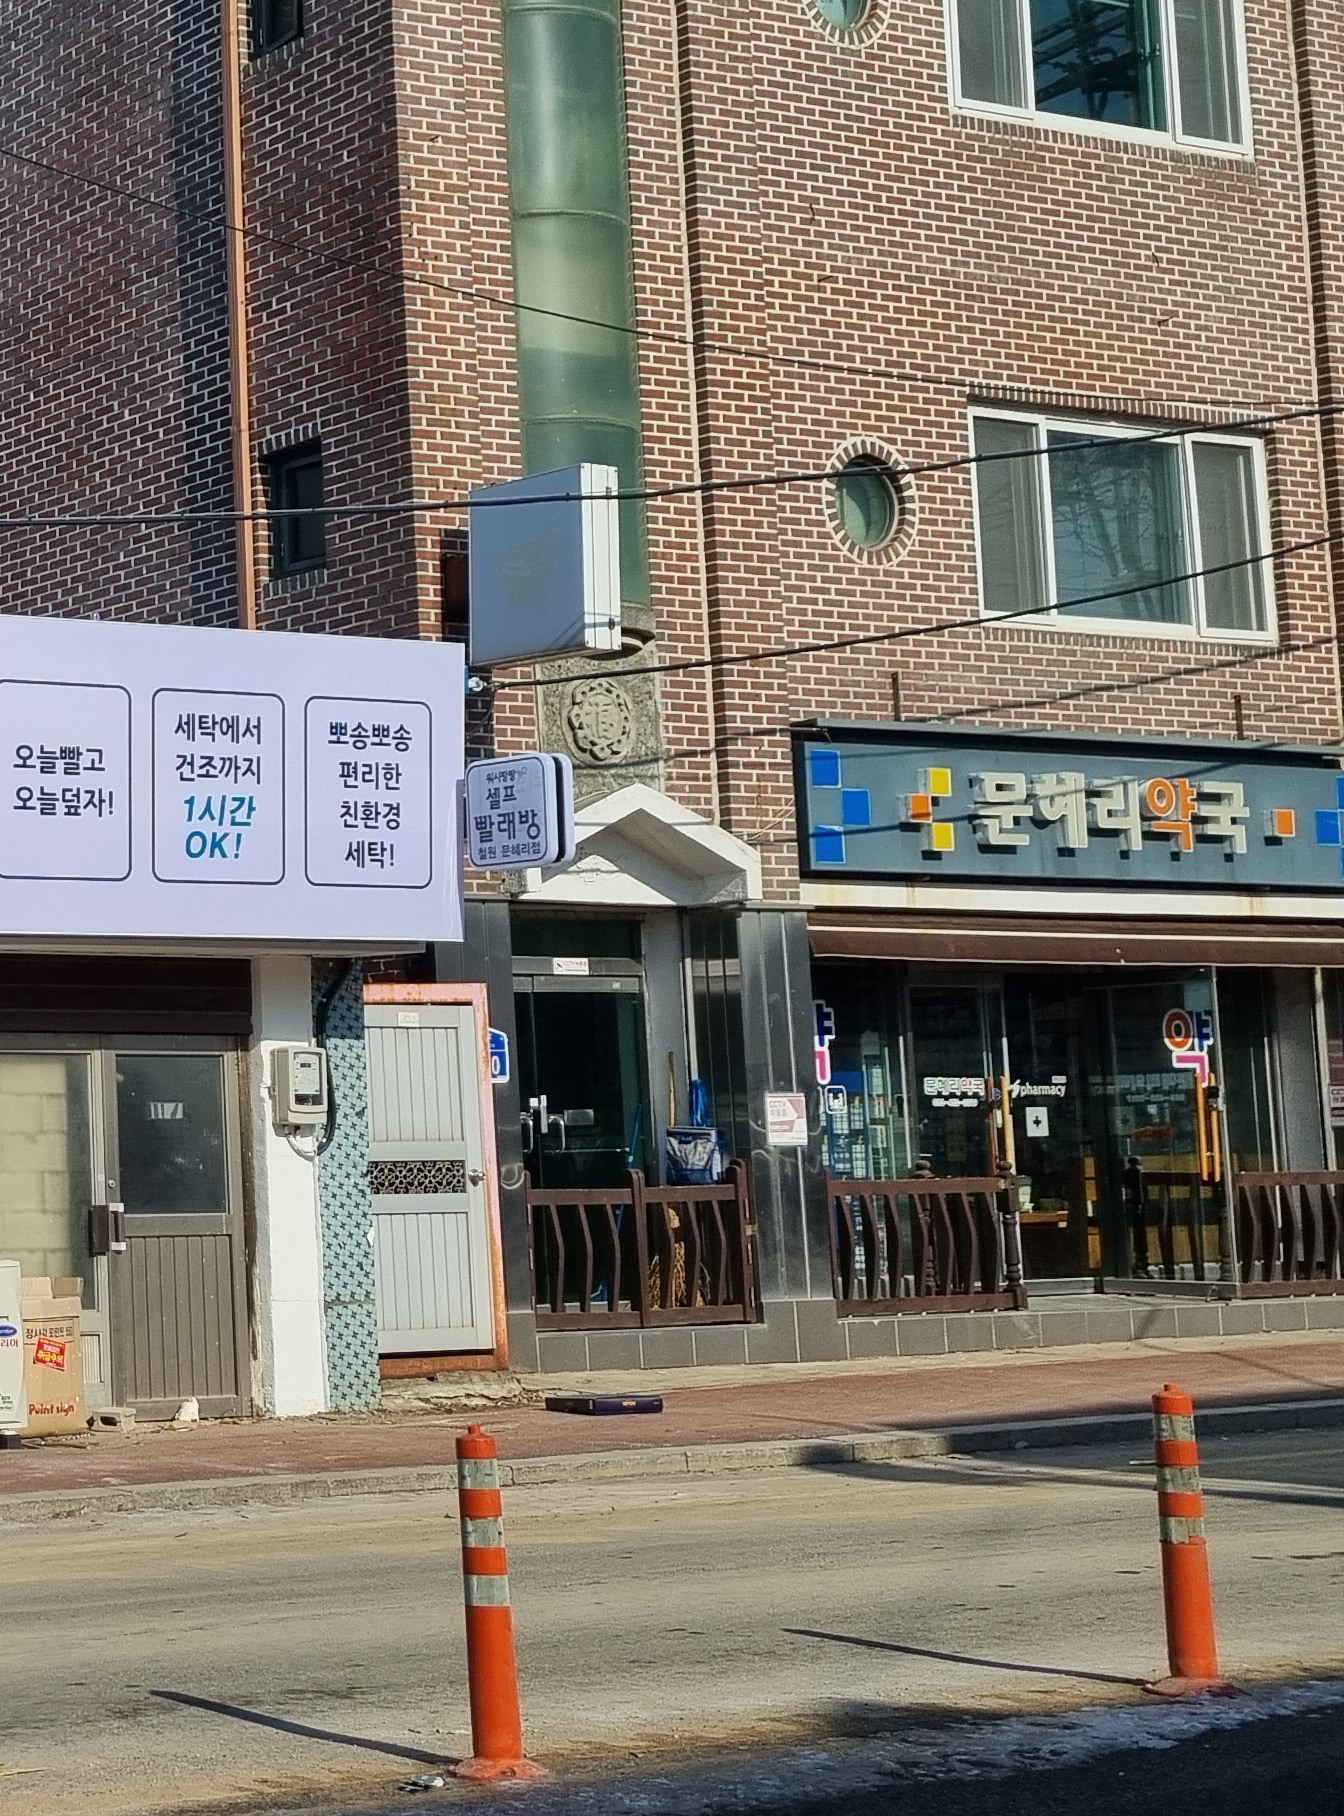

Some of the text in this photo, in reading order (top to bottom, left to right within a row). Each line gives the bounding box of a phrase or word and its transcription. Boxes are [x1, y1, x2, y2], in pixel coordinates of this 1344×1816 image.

[174, 713, 262, 745] 세탁에서
[327, 721, 412, 753] 뽀송뽀송
[13, 744, 106, 775] 오늘빨고
[174, 754, 262, 785] 건조까지
[338, 761, 403, 791] 편리한
[13, 786, 114, 817] 오늘덮자!
[183, 795, 256, 827] 1시간
[486, 785, 517, 810] 셀프
[968, 772, 1249, 854] 문혜리약국
[339, 801, 401, 831] 친환경
[474, 809, 541, 843] 빨래방
[185, 832, 242, 860] OK!
[344, 840, 395, 868] 세탁!
[1020, 1082, 1067, 1098] pharmacy
[28, 1403, 55, 1415] Point
